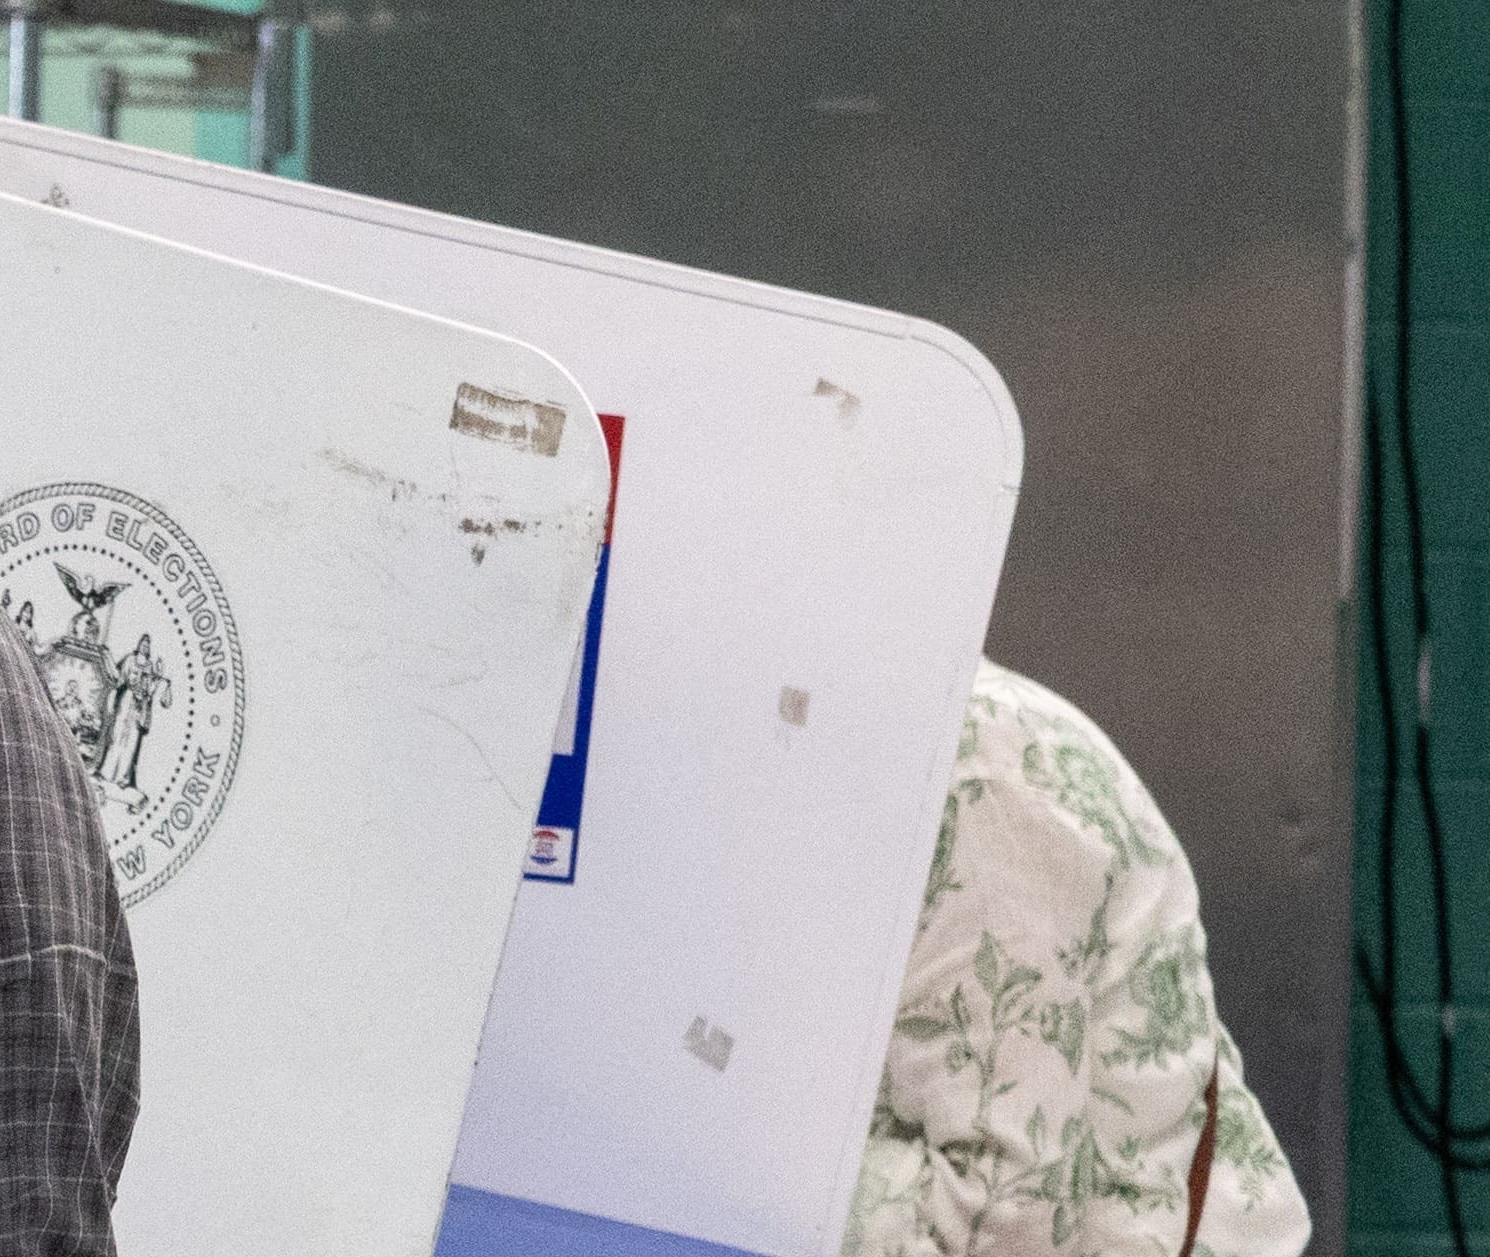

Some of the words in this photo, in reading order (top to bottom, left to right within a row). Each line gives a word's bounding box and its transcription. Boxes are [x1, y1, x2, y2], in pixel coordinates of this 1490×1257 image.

[51, 503, 97, 533] OF
[105, 512, 228, 694] ELECTIONS
[151, 745, 221, 850] YORK
